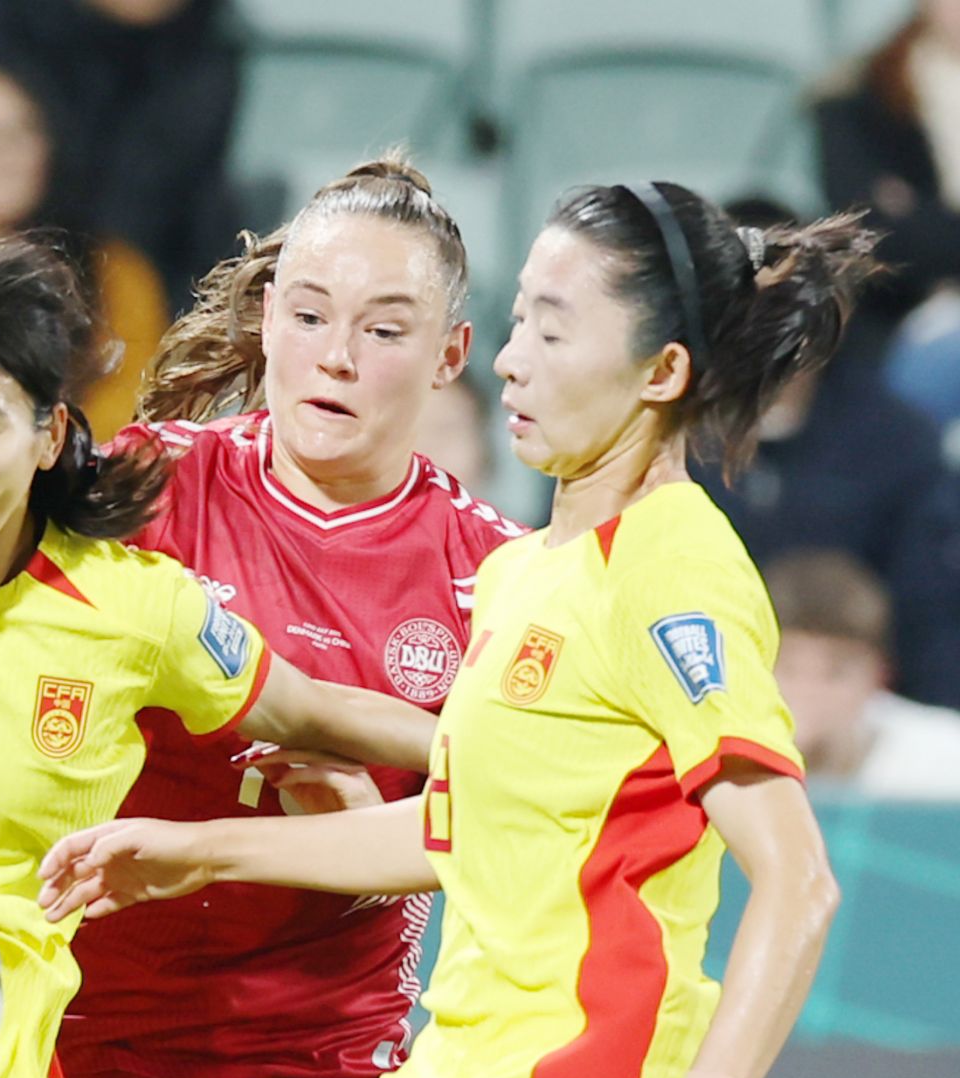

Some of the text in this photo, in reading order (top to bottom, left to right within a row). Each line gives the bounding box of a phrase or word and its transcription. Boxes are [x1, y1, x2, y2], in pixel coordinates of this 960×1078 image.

[527, 633, 559, 656] CFA
[400, 644, 446, 674] DBU
[439, 651, 461, 695] UNION
[43, 683, 86, 702] CFA
